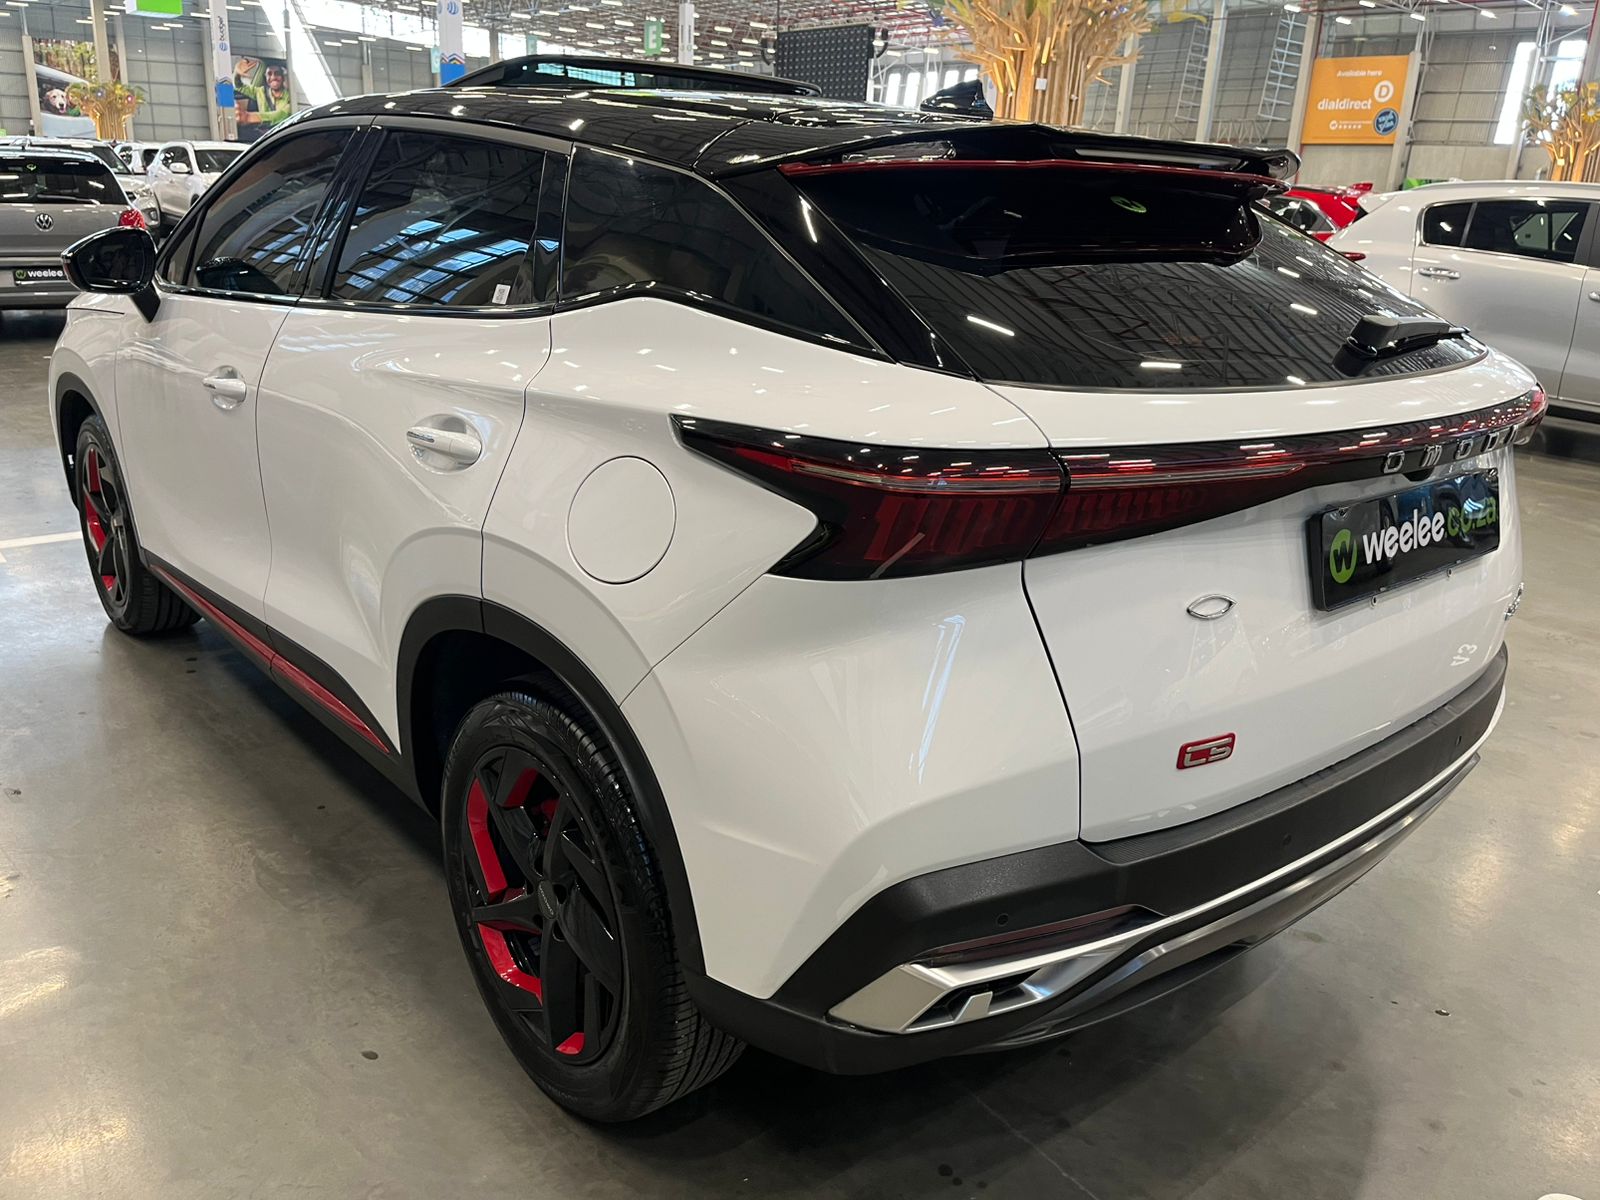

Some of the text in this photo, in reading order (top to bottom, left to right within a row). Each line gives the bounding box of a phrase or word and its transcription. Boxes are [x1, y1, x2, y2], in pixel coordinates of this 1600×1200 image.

[649, 25, 656, 48] E
[1337, 69, 1383, 78] Available here
[1318, 98, 1372, 110] dialdirect
